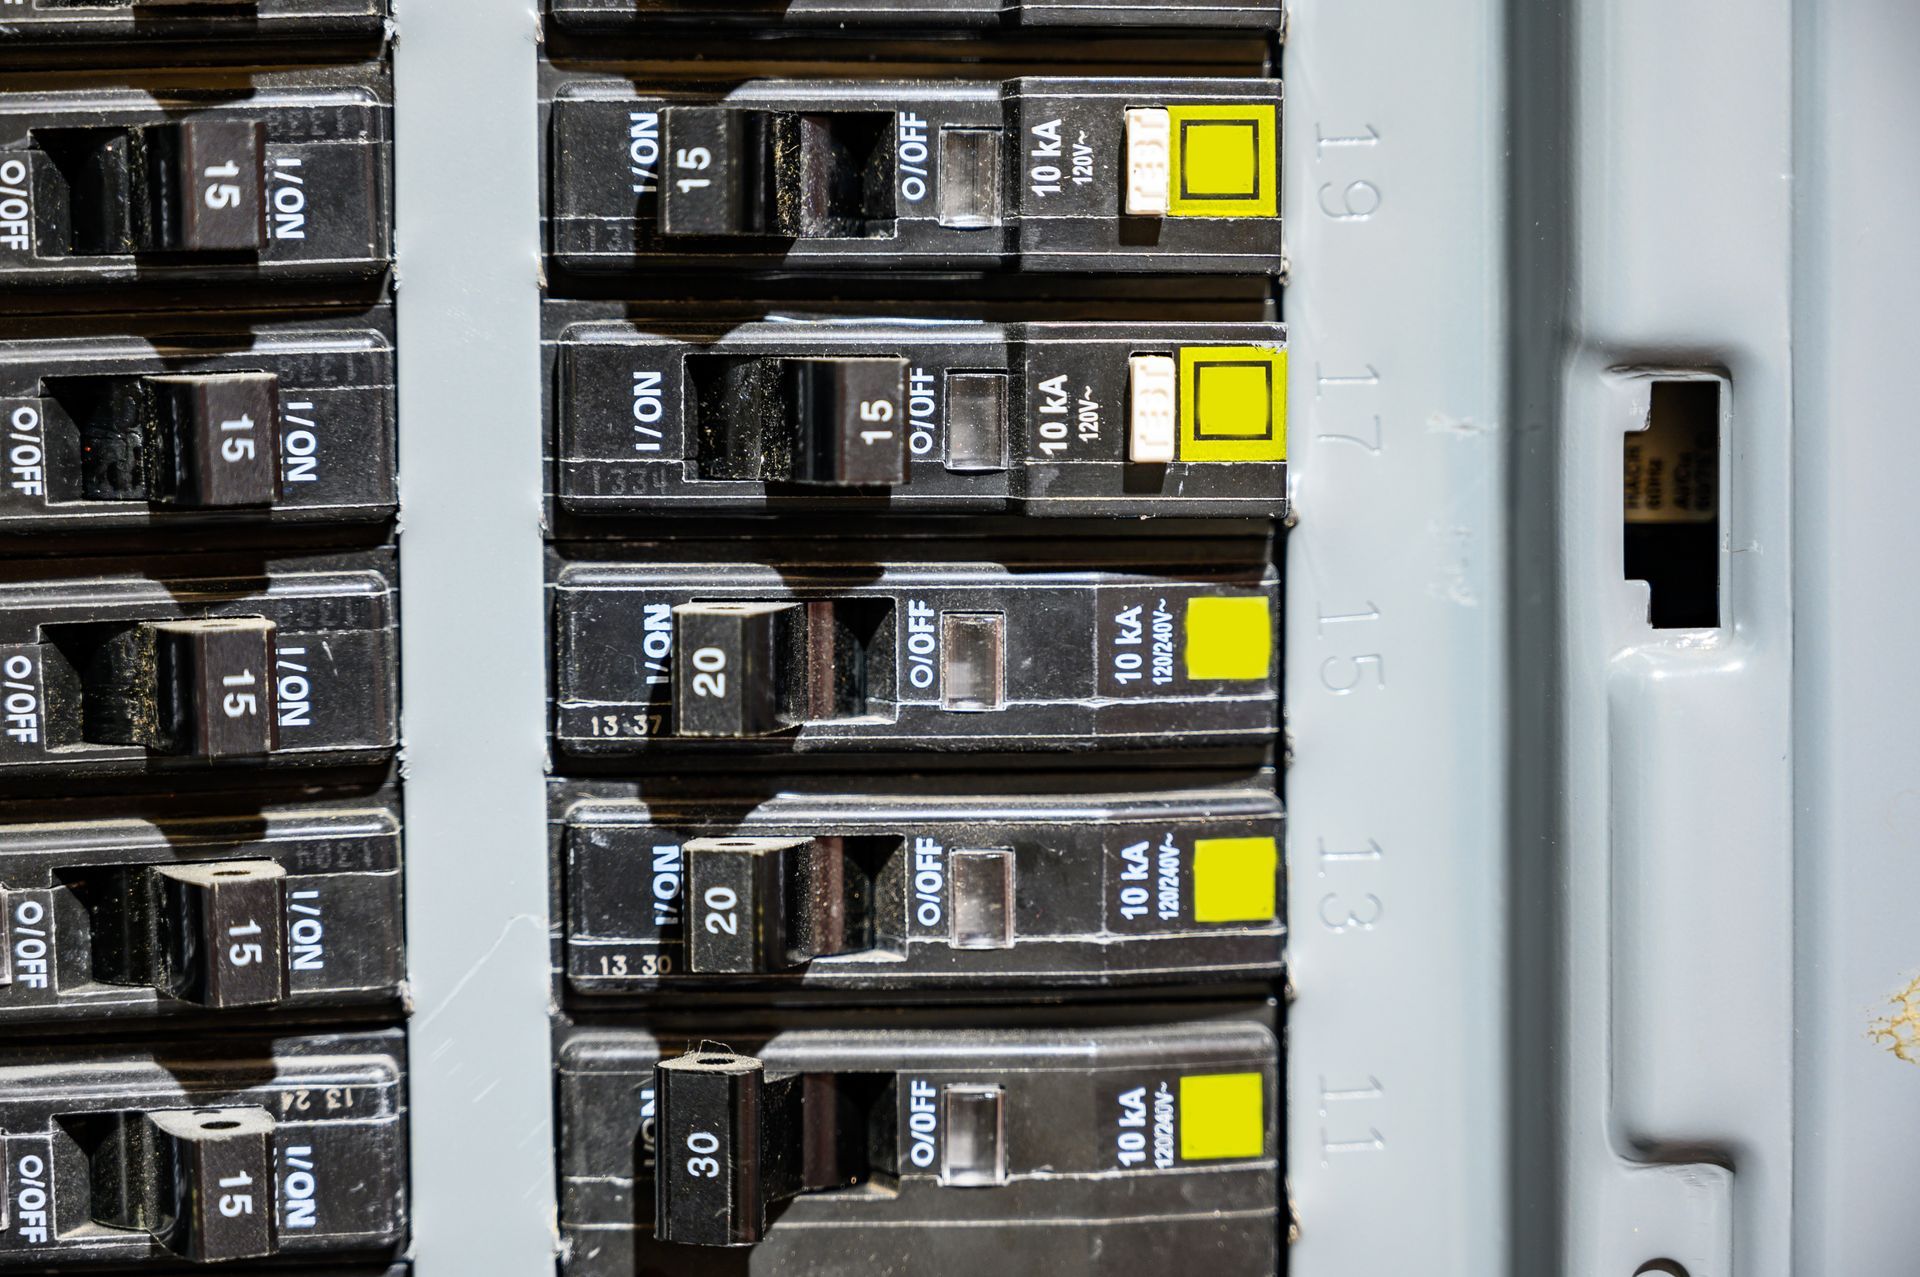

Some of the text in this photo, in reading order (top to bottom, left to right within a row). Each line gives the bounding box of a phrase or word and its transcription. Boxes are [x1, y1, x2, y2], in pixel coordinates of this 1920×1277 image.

[203, 159, 242, 210] 15
[629, 112, 659, 194] I/ON
[676, 145, 712, 194] 15
[899, 111, 929, 202] O/OFF
[1030, 118, 1063, 198] 10 kA
[1315, 121, 1381, 222] 19
[273, 157, 306, 240] I/ON
[220, 412, 256, 463] 15
[286, 401, 318, 483] I/ON
[632, 370, 664, 452] I/ON
[859, 399, 895, 446] 15
[1038, 373, 1069, 457] 10 kA
[1315, 361, 1382, 456] 17
[691, 646, 727, 700] 20
[908, 598, 936, 690] O/OFF
[1113, 604, 1144, 686] 10 kA
[1316, 599, 1387, 697] 15
[222, 668, 257, 719] 15
[277, 645, 311, 727] I/ON
[590, 714, 663, 737] 13 37
[704, 885, 739, 937] 20
[914, 836, 943, 928] O/OFF
[1120, 840, 1150, 921] 10 kA
[1317, 835, 1385, 935] 13
[228, 918, 263, 968] 15
[290, 890, 324, 971] I/ON
[599, 954, 673, 977] 13 30
[281, 1087, 355, 1112] 13 24
[909, 1079, 937, 1169] O/OFF
[1117, 1085, 1147, 1168] 10 kA
[1319, 1073, 1385, 1170] 11
[218, 1170, 254, 1219] 15
[284, 1145, 317, 1230] I/ON
[686, 1130, 721, 1180] 30
